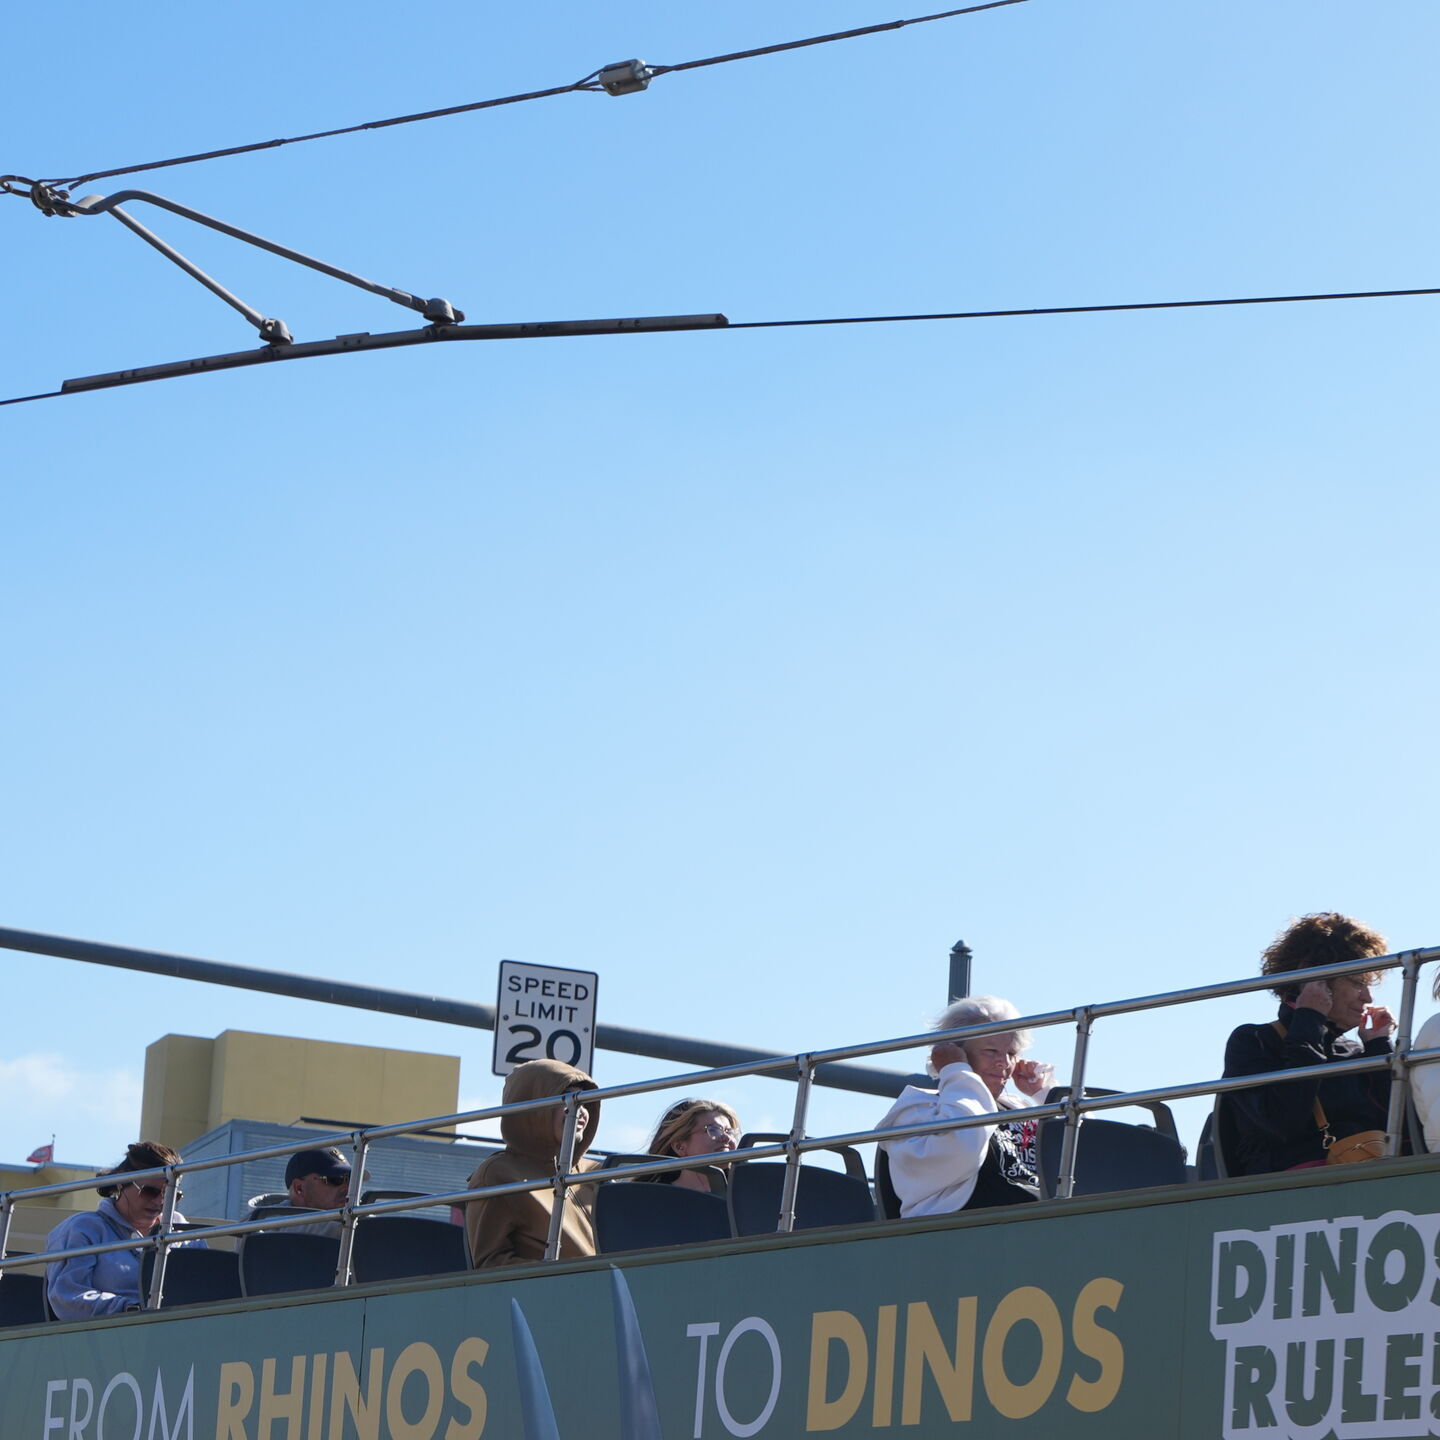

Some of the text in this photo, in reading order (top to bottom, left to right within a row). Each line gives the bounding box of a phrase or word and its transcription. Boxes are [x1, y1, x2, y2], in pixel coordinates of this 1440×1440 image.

[507, 975, 589, 1001] SPEED
[514, 999, 578, 1023] LIMIT
[505, 1024, 582, 1068] 20
[686, 1316, 782, 1439] TO
[806, 1276, 1125, 1432] DINOS
